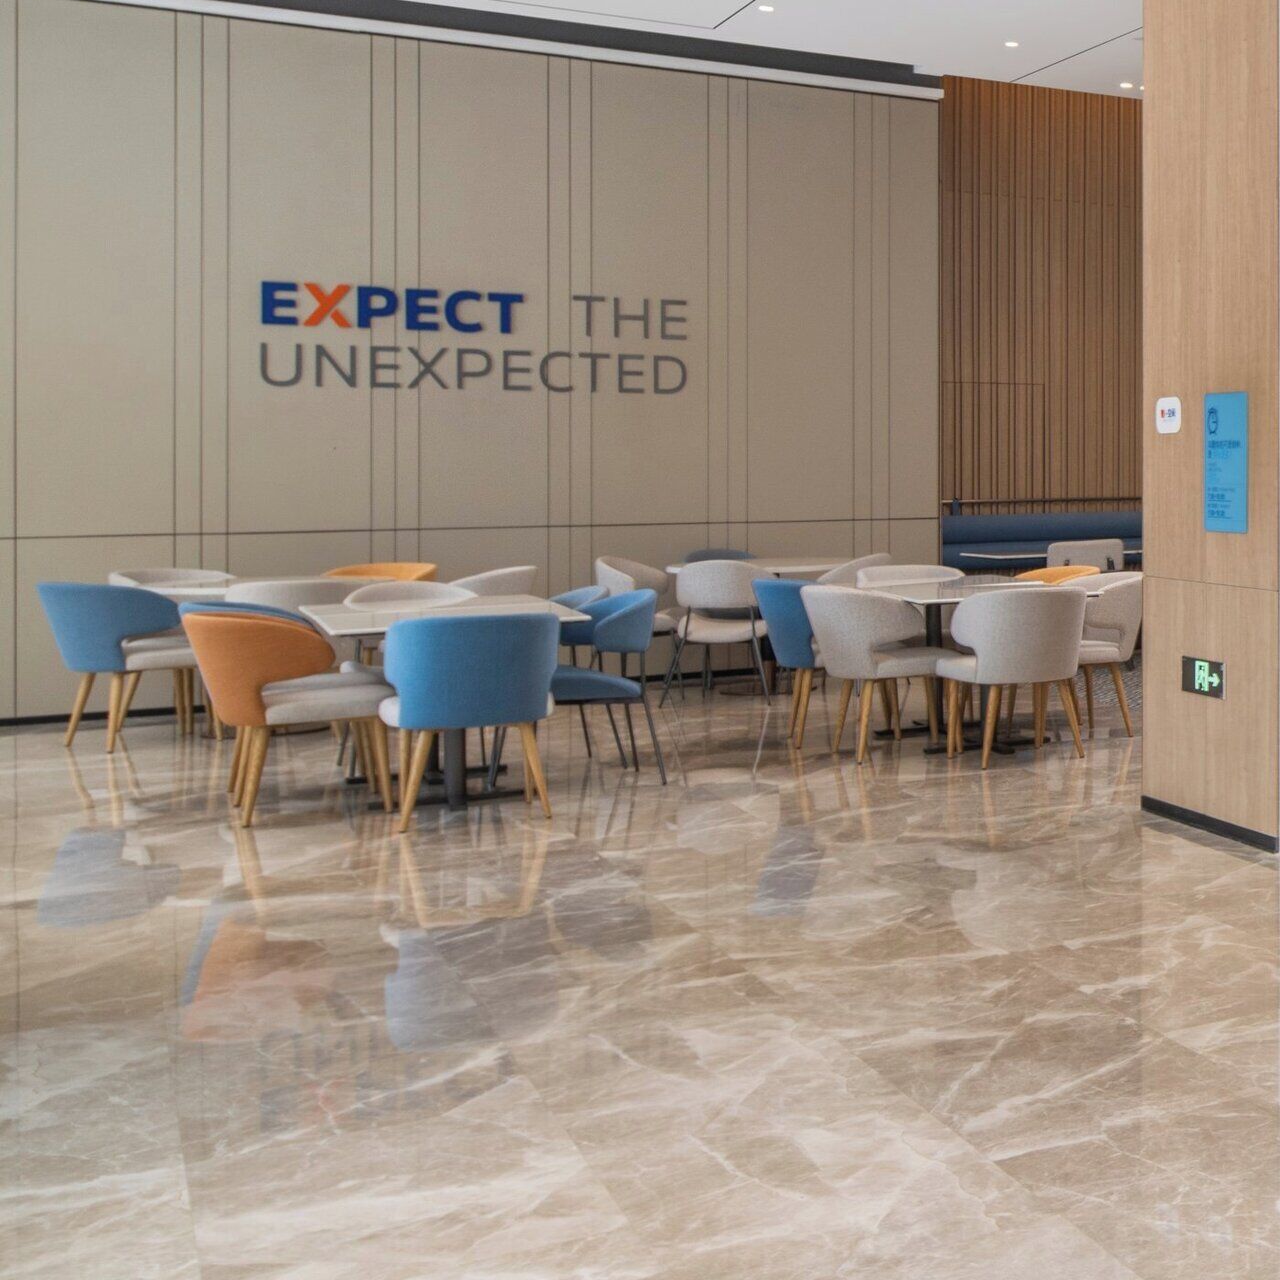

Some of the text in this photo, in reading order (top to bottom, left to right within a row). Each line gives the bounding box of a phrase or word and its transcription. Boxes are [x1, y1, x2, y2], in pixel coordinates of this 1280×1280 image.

[260, 280, 689, 341] EXPECT THE
[259, 342, 688, 395] UNEXPECTED
